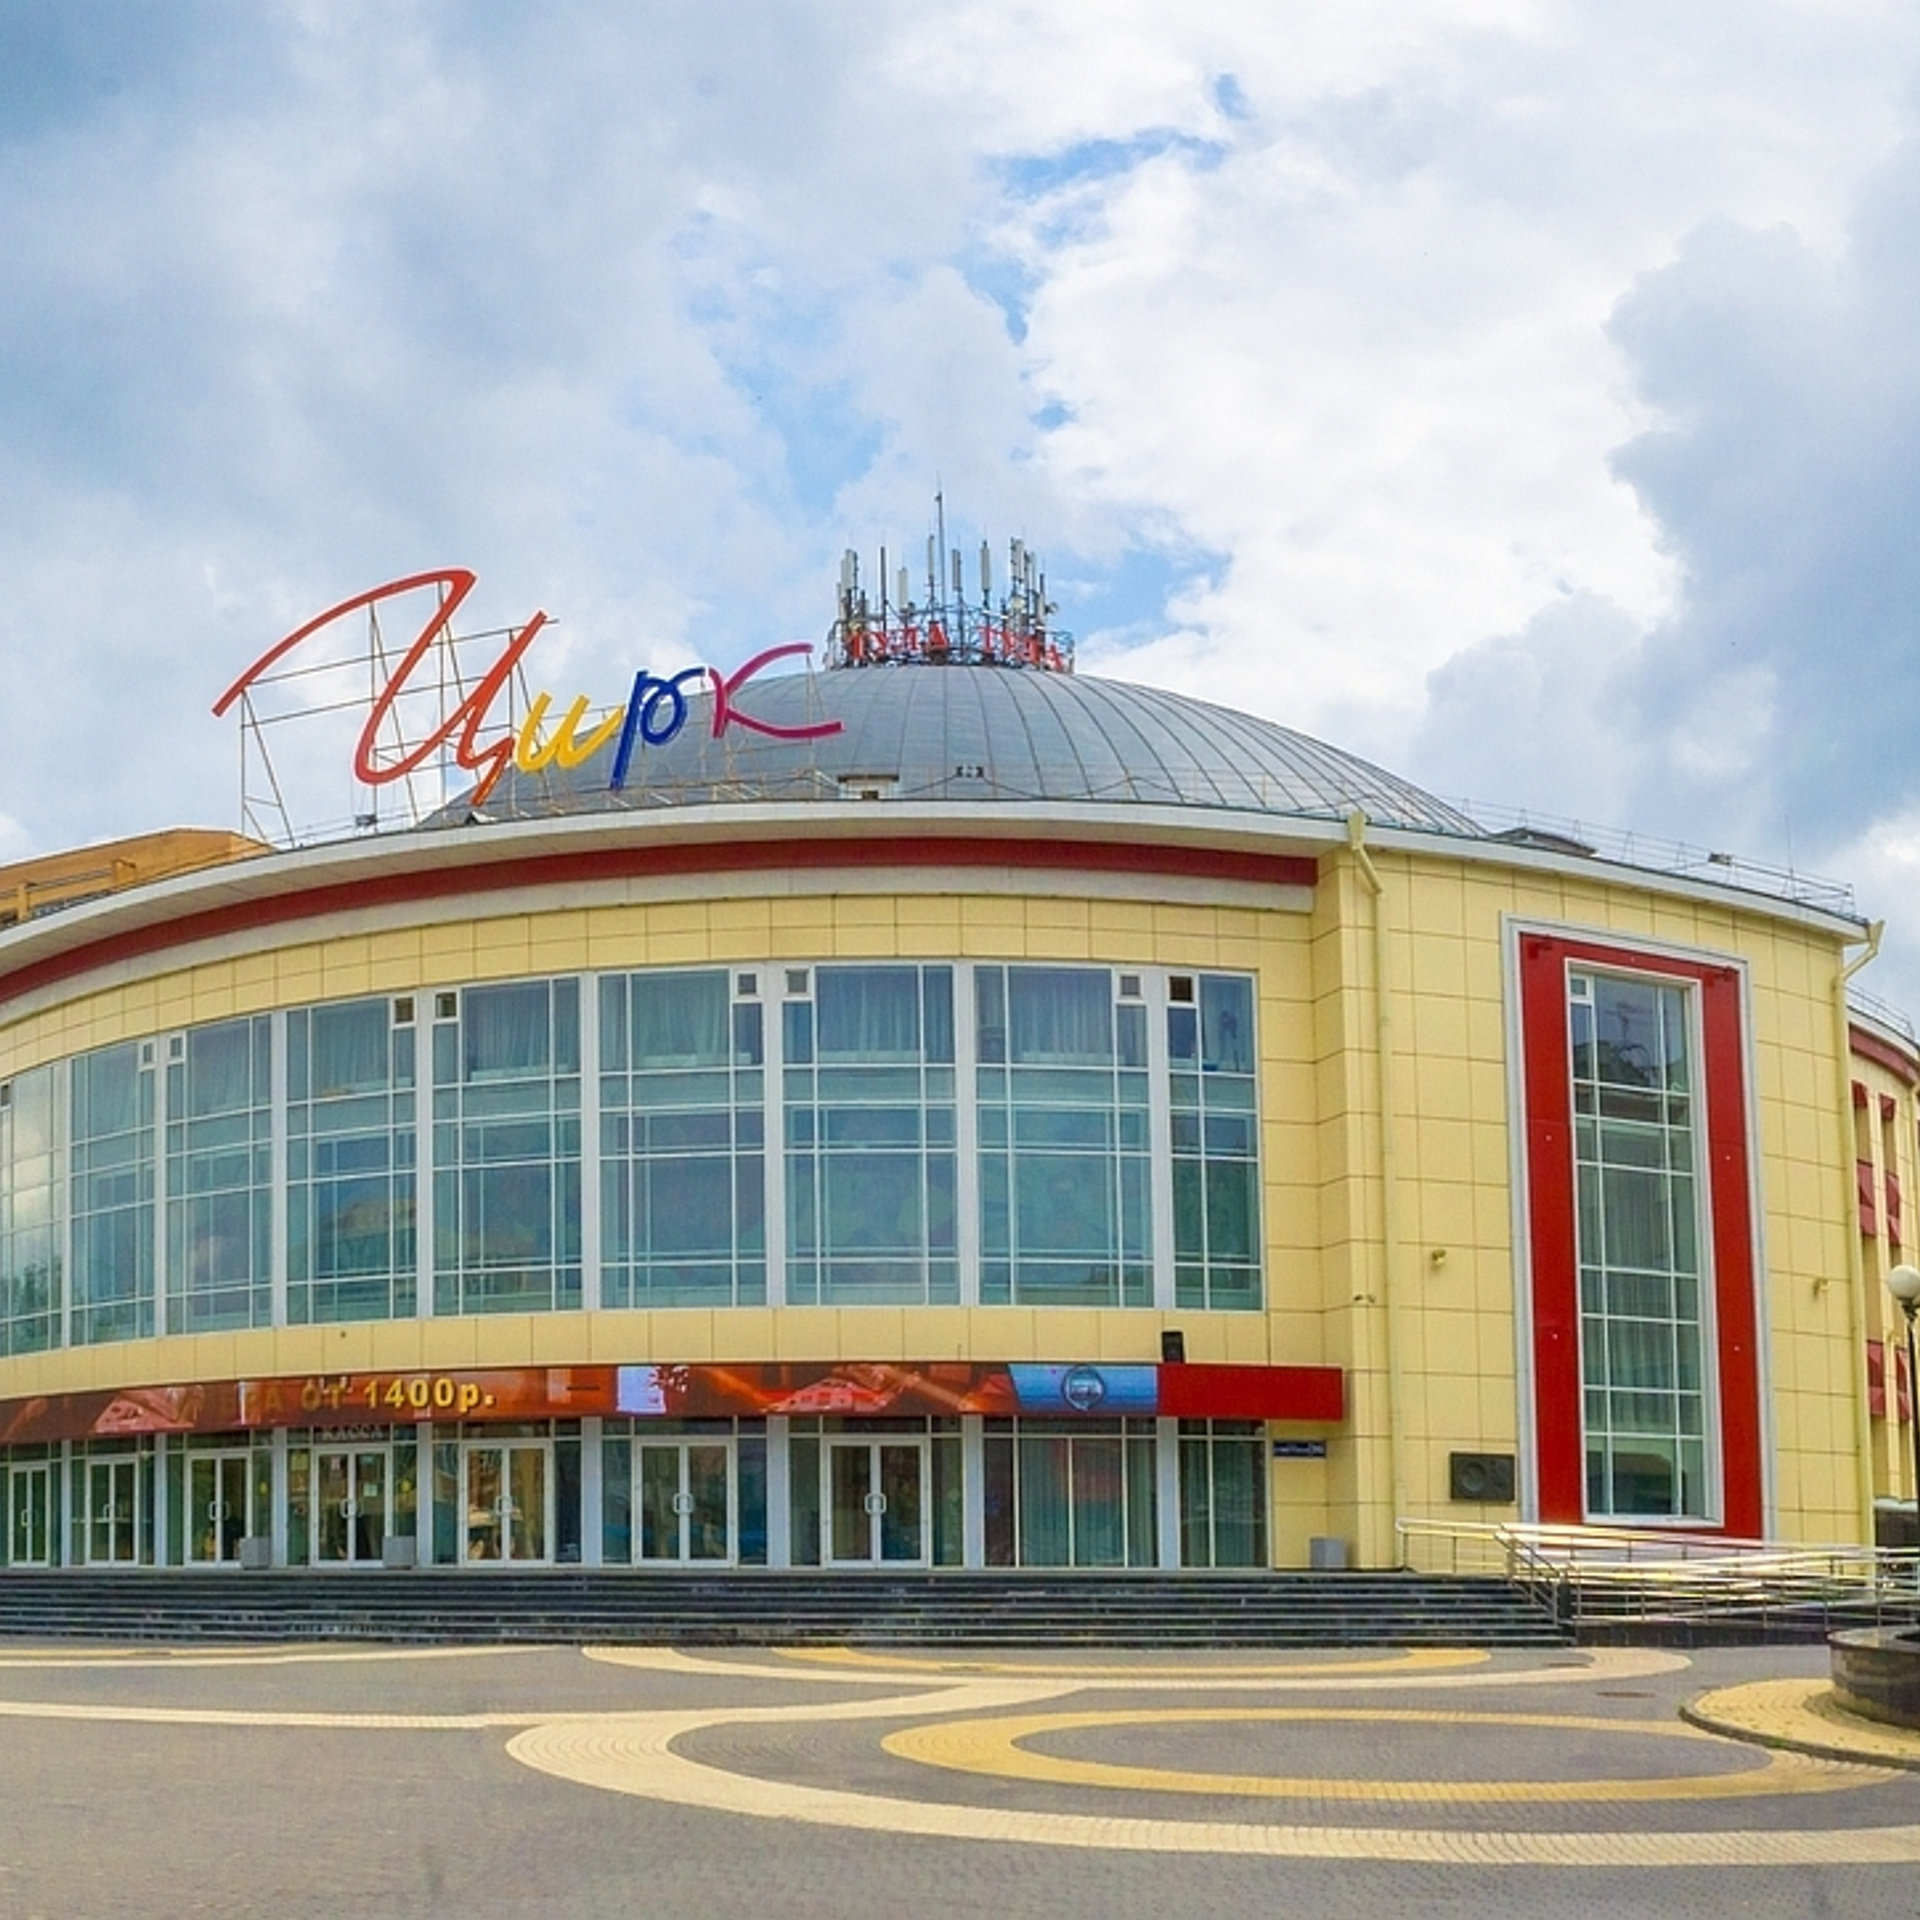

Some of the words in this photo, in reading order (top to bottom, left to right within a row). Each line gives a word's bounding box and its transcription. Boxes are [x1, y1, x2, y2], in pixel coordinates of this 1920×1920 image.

[211, 566, 844, 808] Цирк
[363, 1376, 496, 1413] 1400р.
[322, 1424, 384, 1441] КАССА
